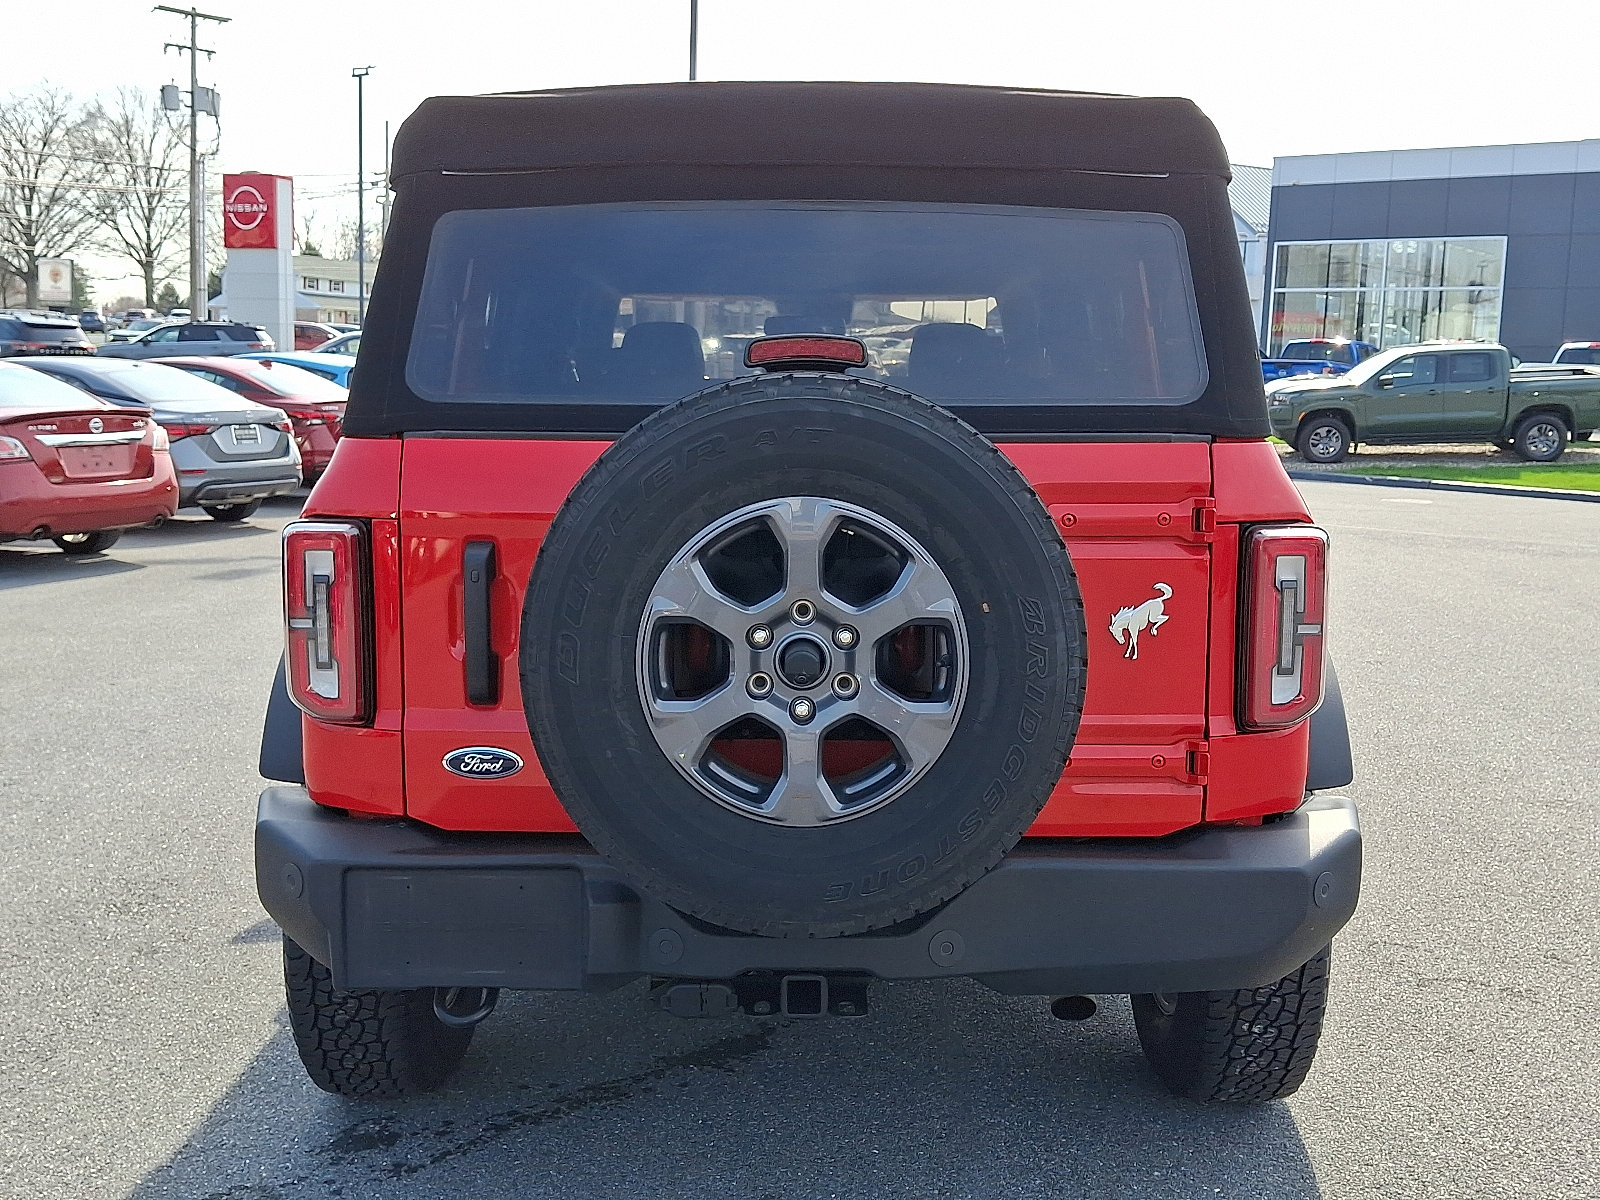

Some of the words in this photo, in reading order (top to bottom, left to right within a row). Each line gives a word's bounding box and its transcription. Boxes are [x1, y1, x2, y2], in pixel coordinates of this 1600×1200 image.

[226, 203, 268, 213] NISSAN
[557, 432, 728, 685] DUELER
[460, 753, 504, 772] Ford
[823, 593, 1050, 903] BRIDGESTONE
